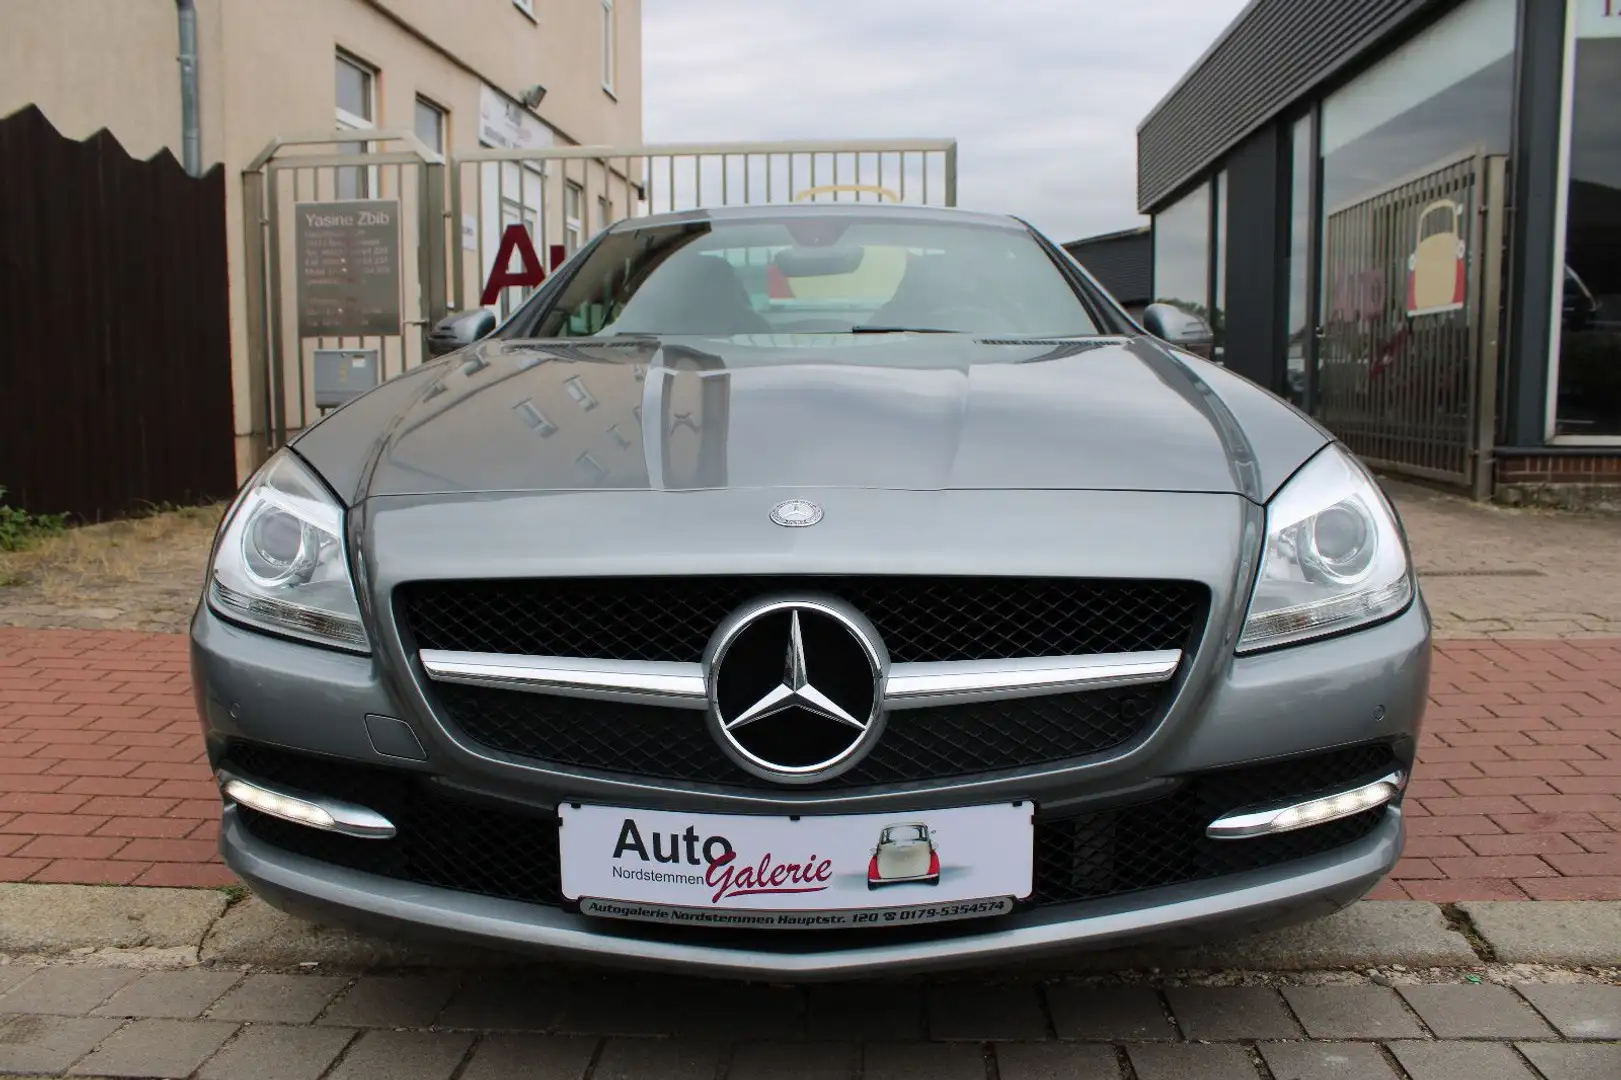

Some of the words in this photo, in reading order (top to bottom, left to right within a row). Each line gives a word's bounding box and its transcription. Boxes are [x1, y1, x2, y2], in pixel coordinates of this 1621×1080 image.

[305, 213, 353, 227] Yasine
[357, 211, 390, 226] Zbib
[612, 818, 733, 867] Auto
[612, 866, 704, 885] Nordstemmen
[705, 851, 833, 904] Galerie
[588, 902, 669, 919] Autogalerie
[670, 910, 774, 925] Nordstemmen
[777, 914, 846, 926] Hauptstr.
[852, 912, 879, 923] 120
[899, 901, 1005, 921] 0179-5354574
